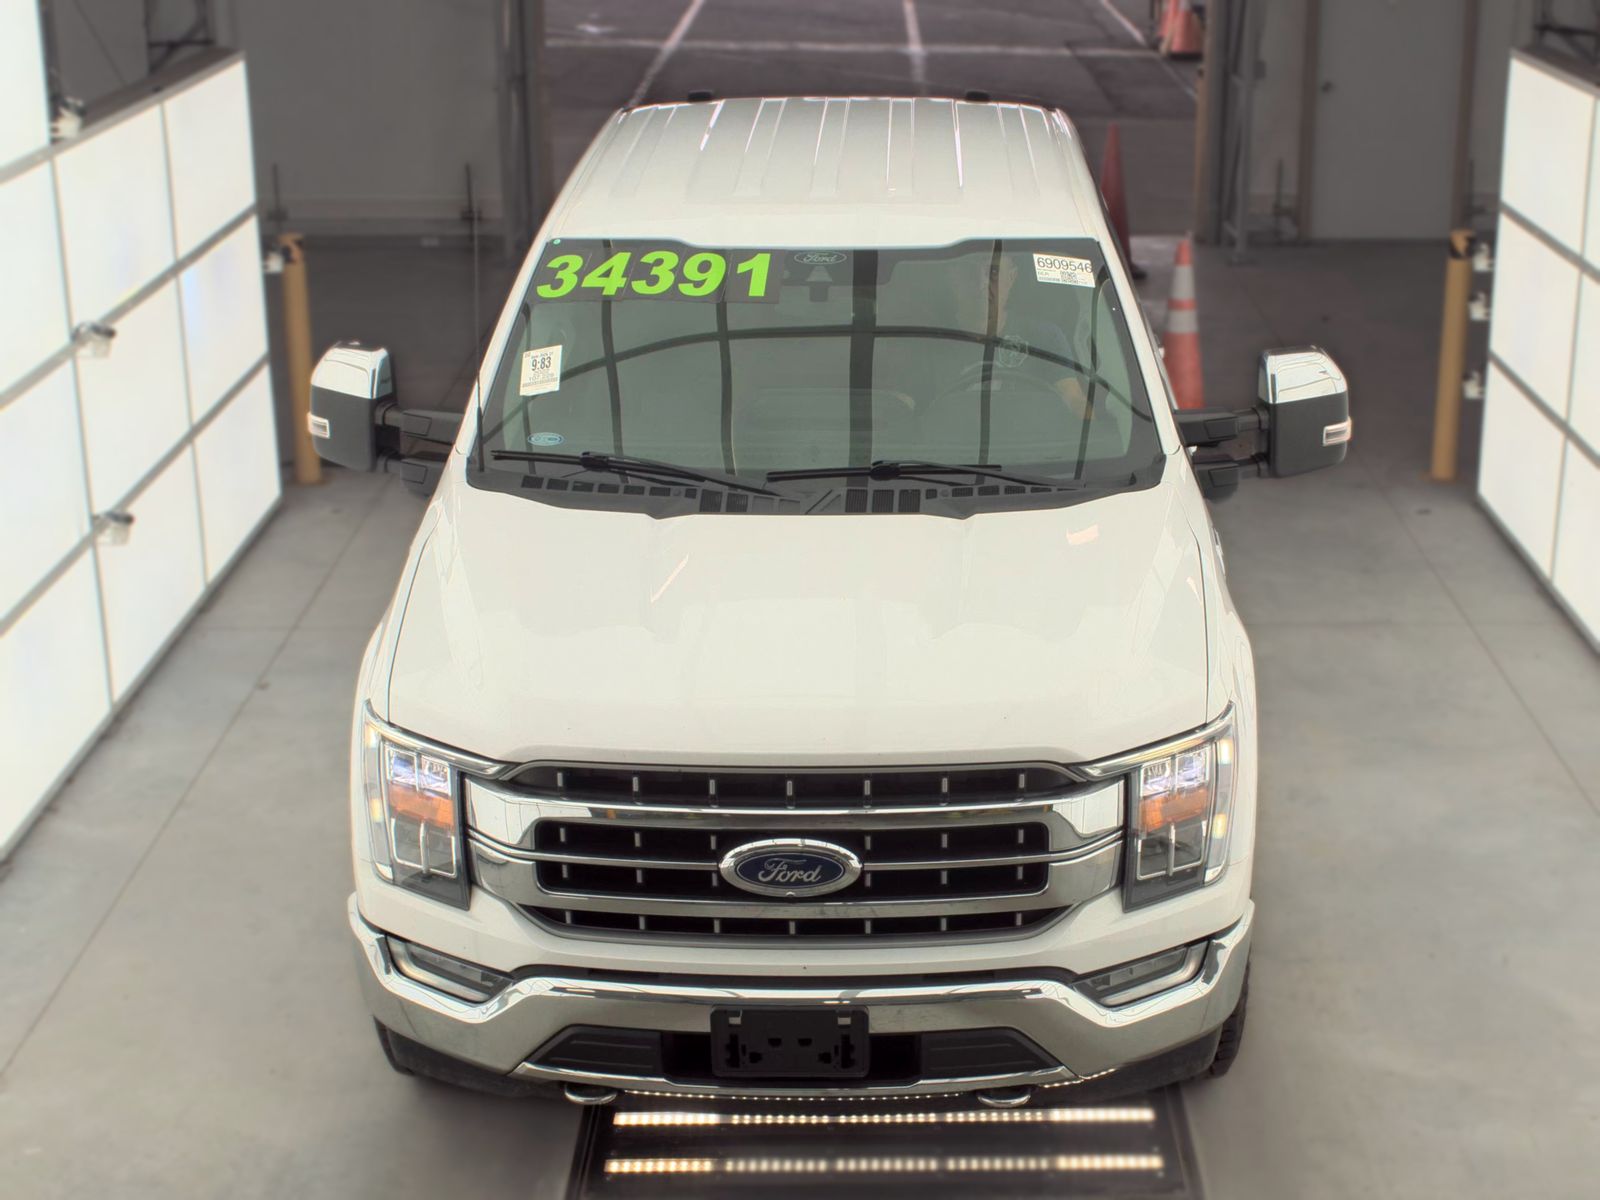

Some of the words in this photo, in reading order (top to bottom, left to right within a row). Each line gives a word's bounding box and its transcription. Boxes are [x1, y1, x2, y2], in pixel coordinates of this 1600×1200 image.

[803, 252, 838, 264] Ford
[1036, 257, 1093, 273] 6909546
[536, 250, 771, 298] 34391
[757, 857, 822, 883] Ford
